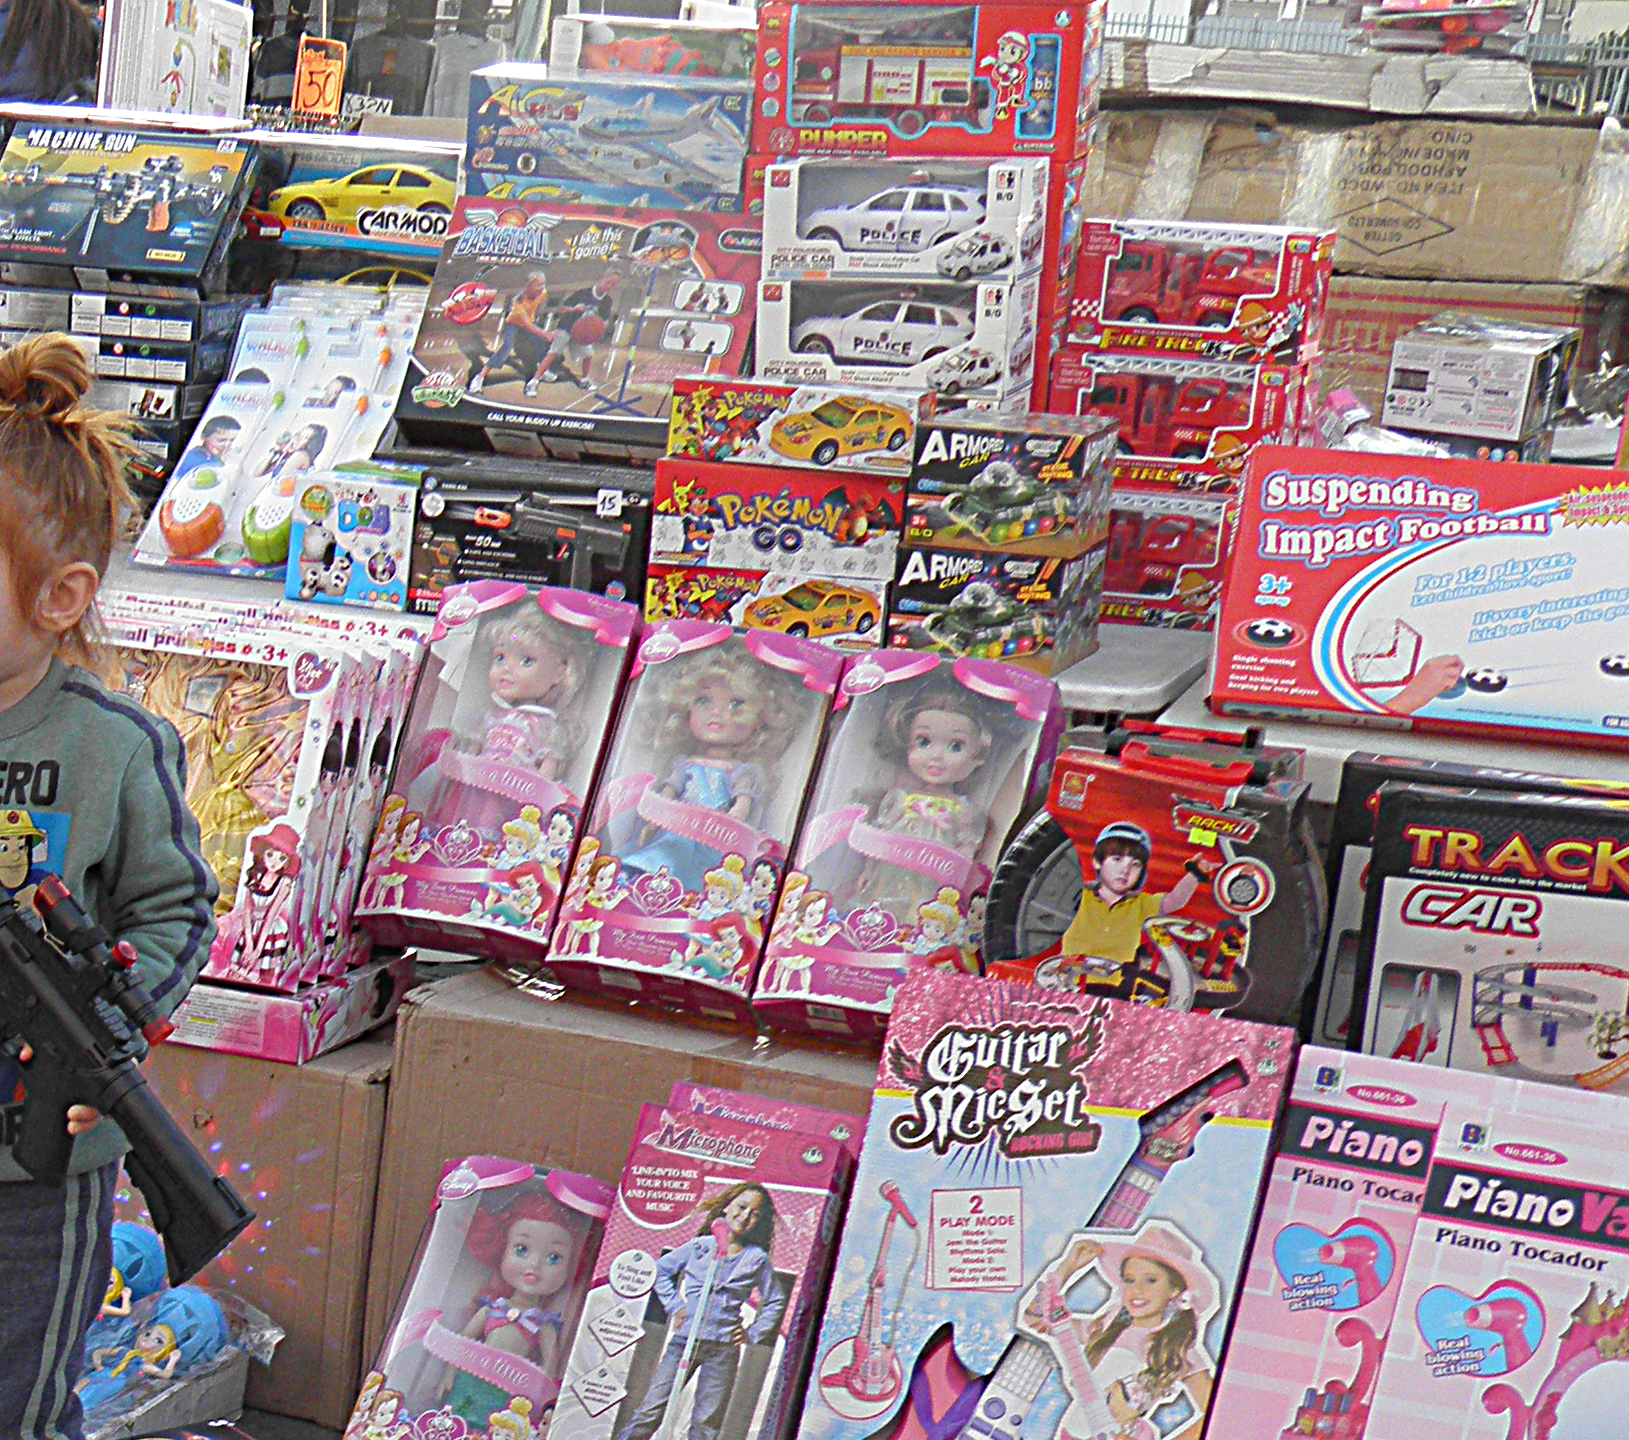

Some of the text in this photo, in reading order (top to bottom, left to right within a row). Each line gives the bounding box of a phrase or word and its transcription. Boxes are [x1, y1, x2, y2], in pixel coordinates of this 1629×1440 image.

[303, 70, 337, 109] 50
[28, 129, 139, 153] MACHINE GUN
[454, 225, 553, 262] BASKETBALL
[580, 231, 600, 246] like
[601, 227, 623, 243] this
[860, 227, 923, 245] POLICE
[771, 255, 835, 264] POLICE CAR
[853, 337, 913, 357] POLICE
[1099, 327, 1151, 349] FIRE
[764, 367, 827, 377] POLICE CAR
[918, 430, 1005, 466] ARMORED
[959, 452, 991, 469] CAR
[598, 495, 617, 512] 15
[1265, 474, 1476, 515] Suspending
[752, 526, 804, 555] GO
[1264, 512, 1548, 563] Impact Football
[899, 551, 984, 587] ARMORED
[939, 573, 971, 590] CAR
[1257, 573, 1292, 594] 3+
[1414, 572, 1452, 592] For
[1509, 622, 1530, 636] or
[1573, 606, 1603, 624] the
[260, 644, 289, 663] 3+
[1408, 866, 1458, 880] Completely
[1459, 872, 1479, 881] new
[1492, 876, 1517, 884] come
[1518, 877, 1536, 886] into
[1537, 879, 1553, 888] the
[1555, 881, 1588, 892] market
[1404, 886, 1540, 937] CAR
[927, 1029, 1070, 1083] Guitar
[986, 1067, 1005, 1090] &
[655, 1123, 763, 1159] Microphone
[1299, 1115, 1424, 1167] Piano
[1291, 1165, 1354, 1193] Piano
[969, 1195, 985, 1215] 2
[1443, 1173, 1576, 1228] Piano
[940, 1215, 1016, 1228] PLAY MODE
[1434, 1227, 1610, 1274] Piano Tocador
[1292, 1273, 1324, 1286] Real
[1283, 1285, 1338, 1303] blowing
[1289, 1297, 1335, 1311] action
[1436, 1337, 1471, 1351] Real
[1426, 1349, 1485, 1367] blowing
[1432, 1362, 1481, 1377] action
